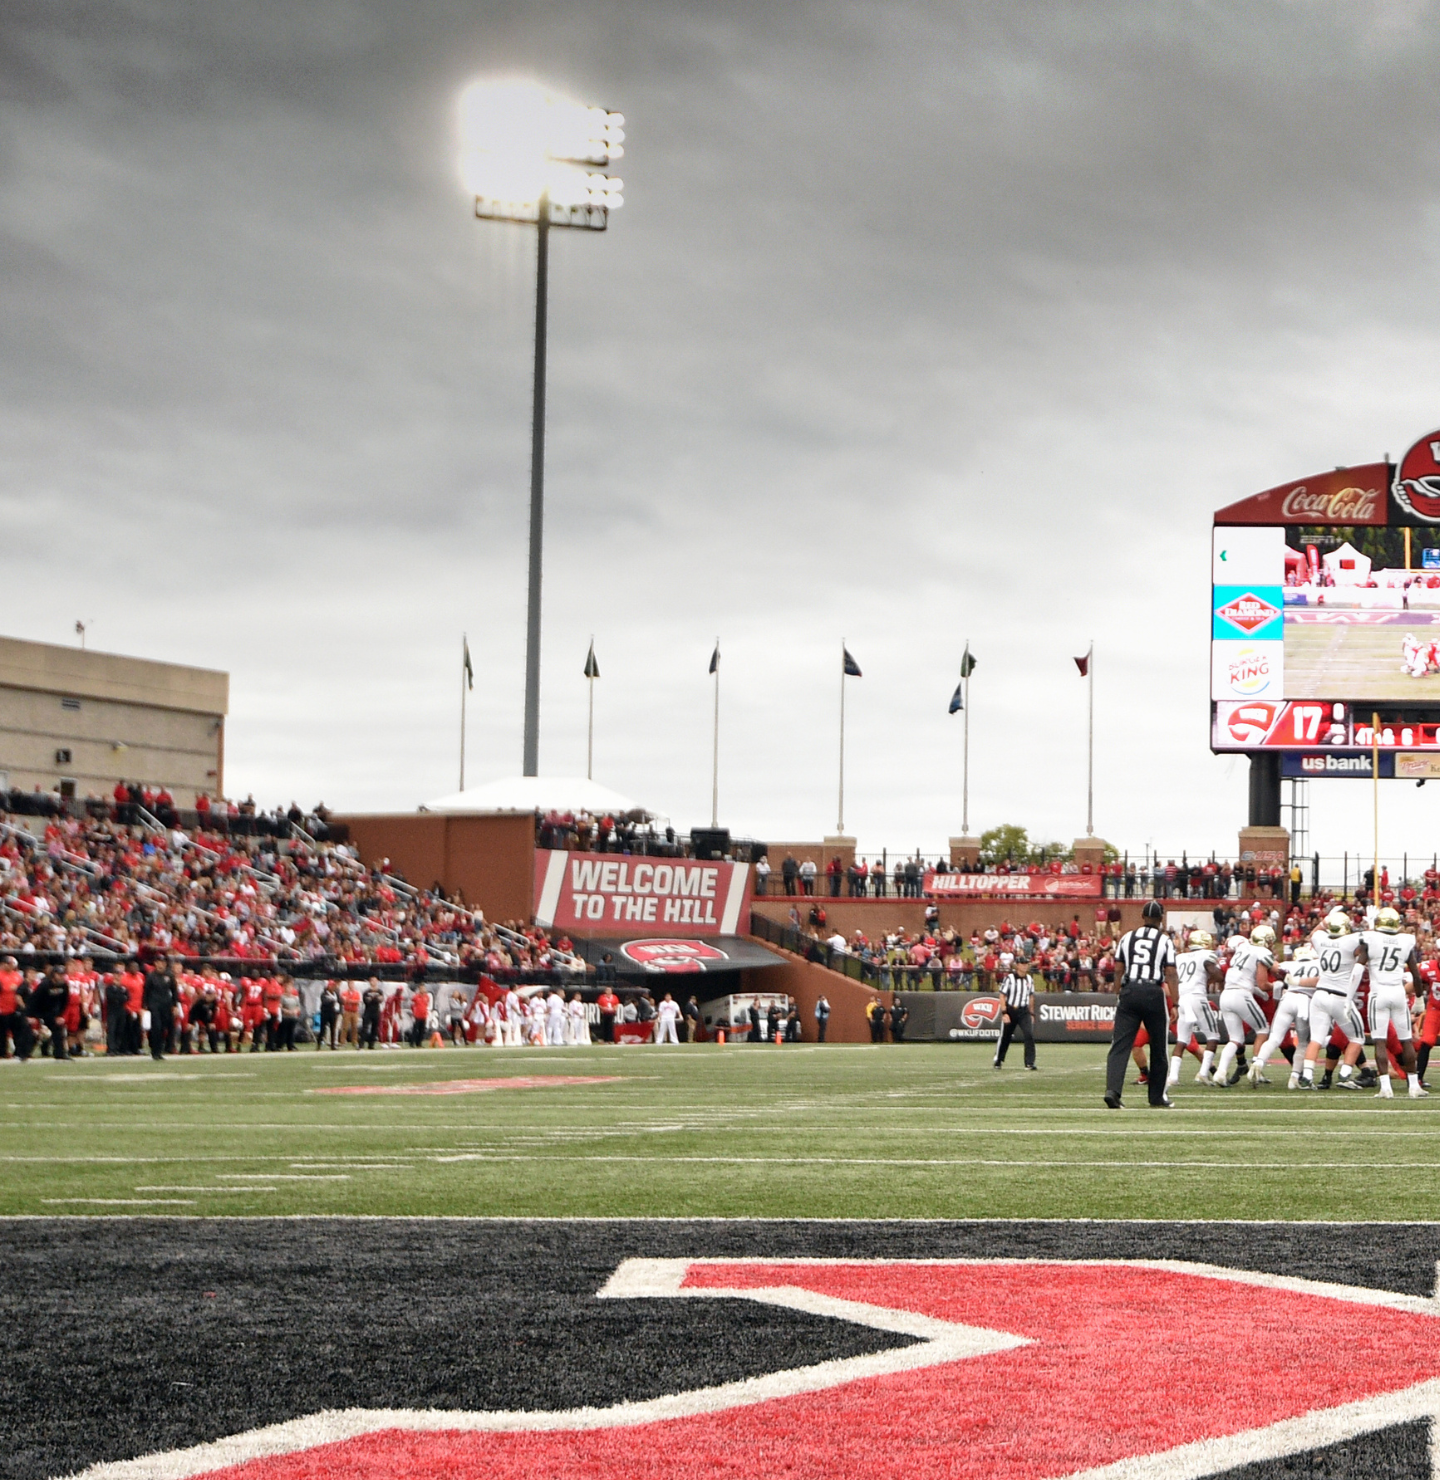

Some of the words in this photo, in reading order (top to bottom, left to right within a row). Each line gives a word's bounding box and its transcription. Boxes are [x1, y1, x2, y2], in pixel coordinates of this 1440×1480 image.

[1282, 486, 1380, 519] Coca-Cola
[1230, 663, 1269, 684] KING
[1293, 706, 1323, 739] 17
[572, 859, 719, 898] WELCOME
[932, 875, 1031, 890] HILLTOPPER
[573, 894, 605, 920] TO
[612, 895, 659, 922] THE
[664, 898, 717, 925] HILL
[637, 944, 700, 954] WKU
[1133, 939, 1154, 965] S
[1378, 946, 1401, 972] 15
[1179, 960, 1197, 983] 29
[1320, 949, 1342, 973] 60
[973, 1003, 993, 1013] WKU
[1040, 1004, 1090, 1021] STEWART
[1090, 1004, 1117, 1021] RICH
[949, 1028, 1000, 1038] @WKUFOOTB
